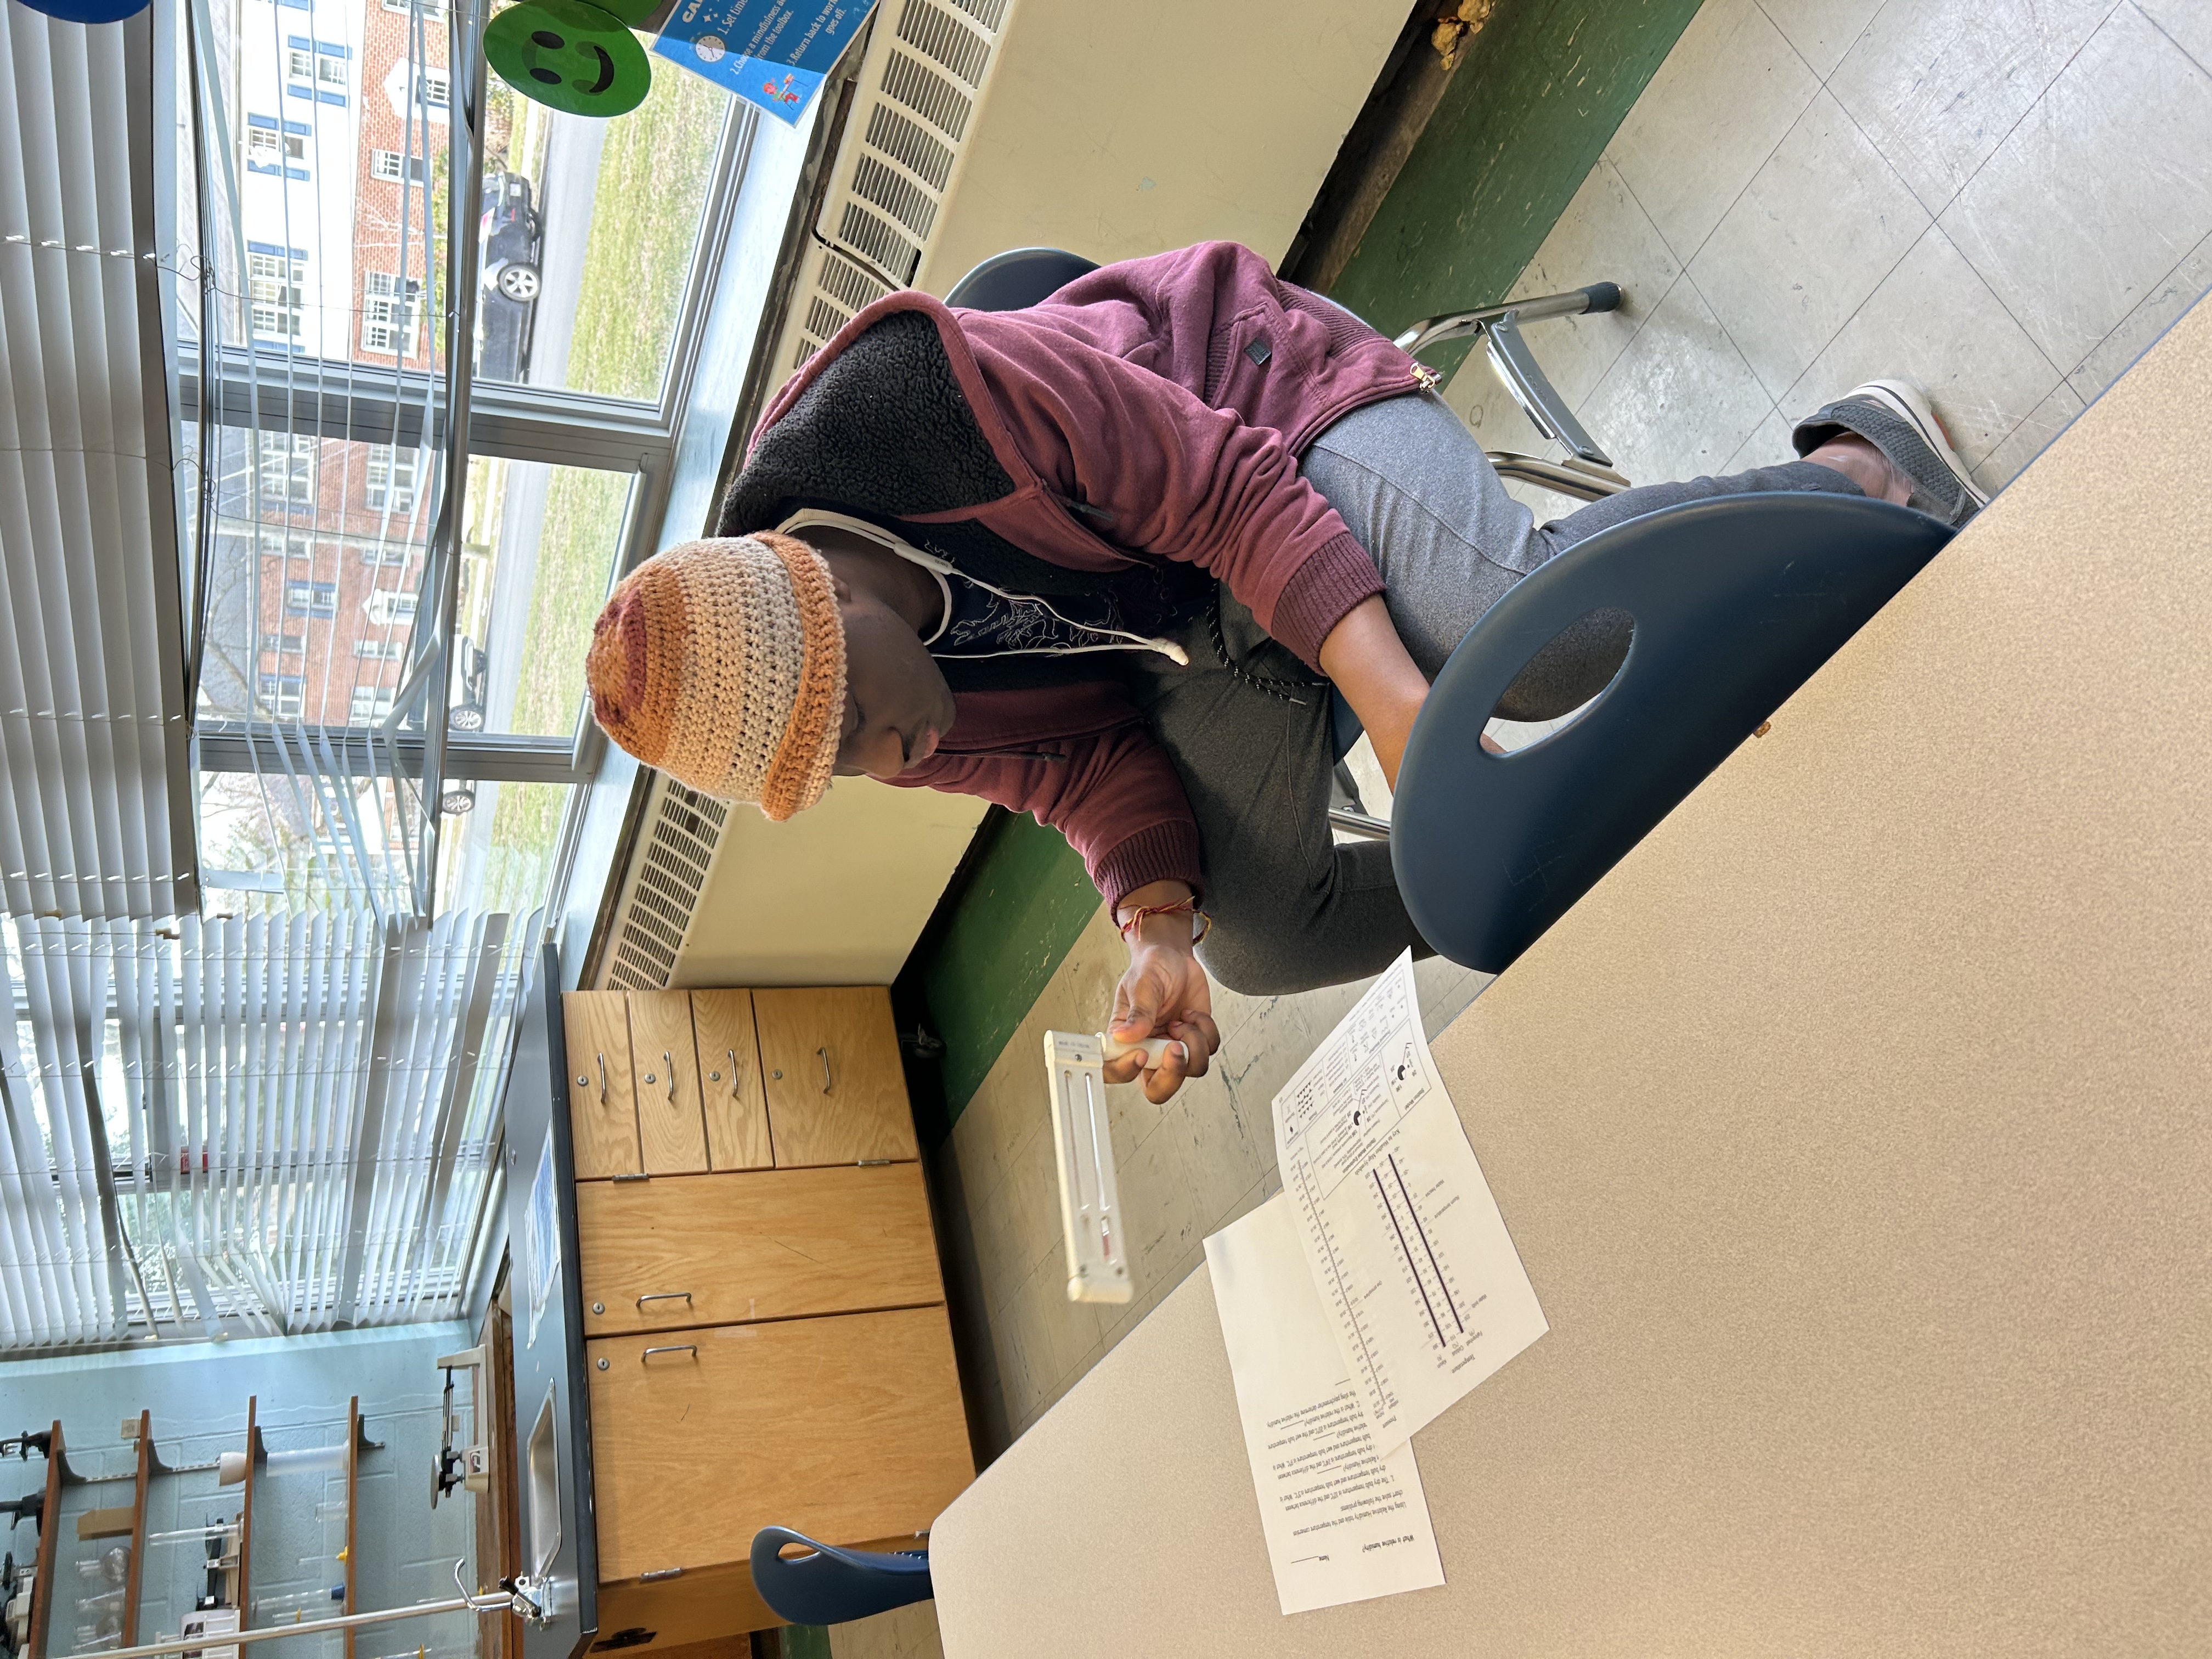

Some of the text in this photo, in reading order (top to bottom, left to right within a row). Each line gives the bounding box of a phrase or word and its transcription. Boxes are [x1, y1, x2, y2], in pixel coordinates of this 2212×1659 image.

[682, 0, 703, 23] CA
[722, 13, 737, 27] Set
[752, 4, 781, 45] mindfulness
[825, 8, 847, 36] goes off.
[804, 22, 822, 40] back
[815, 15, 826, 24] to
[754, 10, 794, 61] from the toolbox.
[1375, 1140, 1389, 1154] Weather
[1452, 1354, 1475, 1373] Temperature
[1318, 1395, 1340, 1409] psychrometer
[1345, 1403, 1355, 1411] What
[1320, 1411, 1334, 1419] relative
[1302, 1415, 1320, 1426] humidity?
[1327, 1417, 1349, 1428] temperature
[1336, 1427, 1354, 1438] humidity?
[1268, 1440, 1288, 1449] temperature
[1340, 1437, 1362, 1447] temperature
[1297, 1452, 1318, 1462] temperature
[1334, 1451, 1357, 1461] temperature
[1291, 1466, 1309, 1475] difference
[1343, 1462, 1361, 1472] Humidity?
[1278, 1471, 1291, 1480] between
[1347, 1470, 1370, 1481] temperature
[1305, 1485, 1325, 1494] temperature
[1342, 1484, 1365, 1494] temperature
[1393, 1489, 1403, 1498] chart
[1299, 1498, 1317, 1507] difference
[1357, 1498, 1374, 1506] following
[1355, 1511, 1372, 1520] Humidity
[1293, 1527, 1310, 1536] conversion
[1311, 1522, 1331, 1531] temperature
[1362, 1543, 1381, 1553] humidity?
